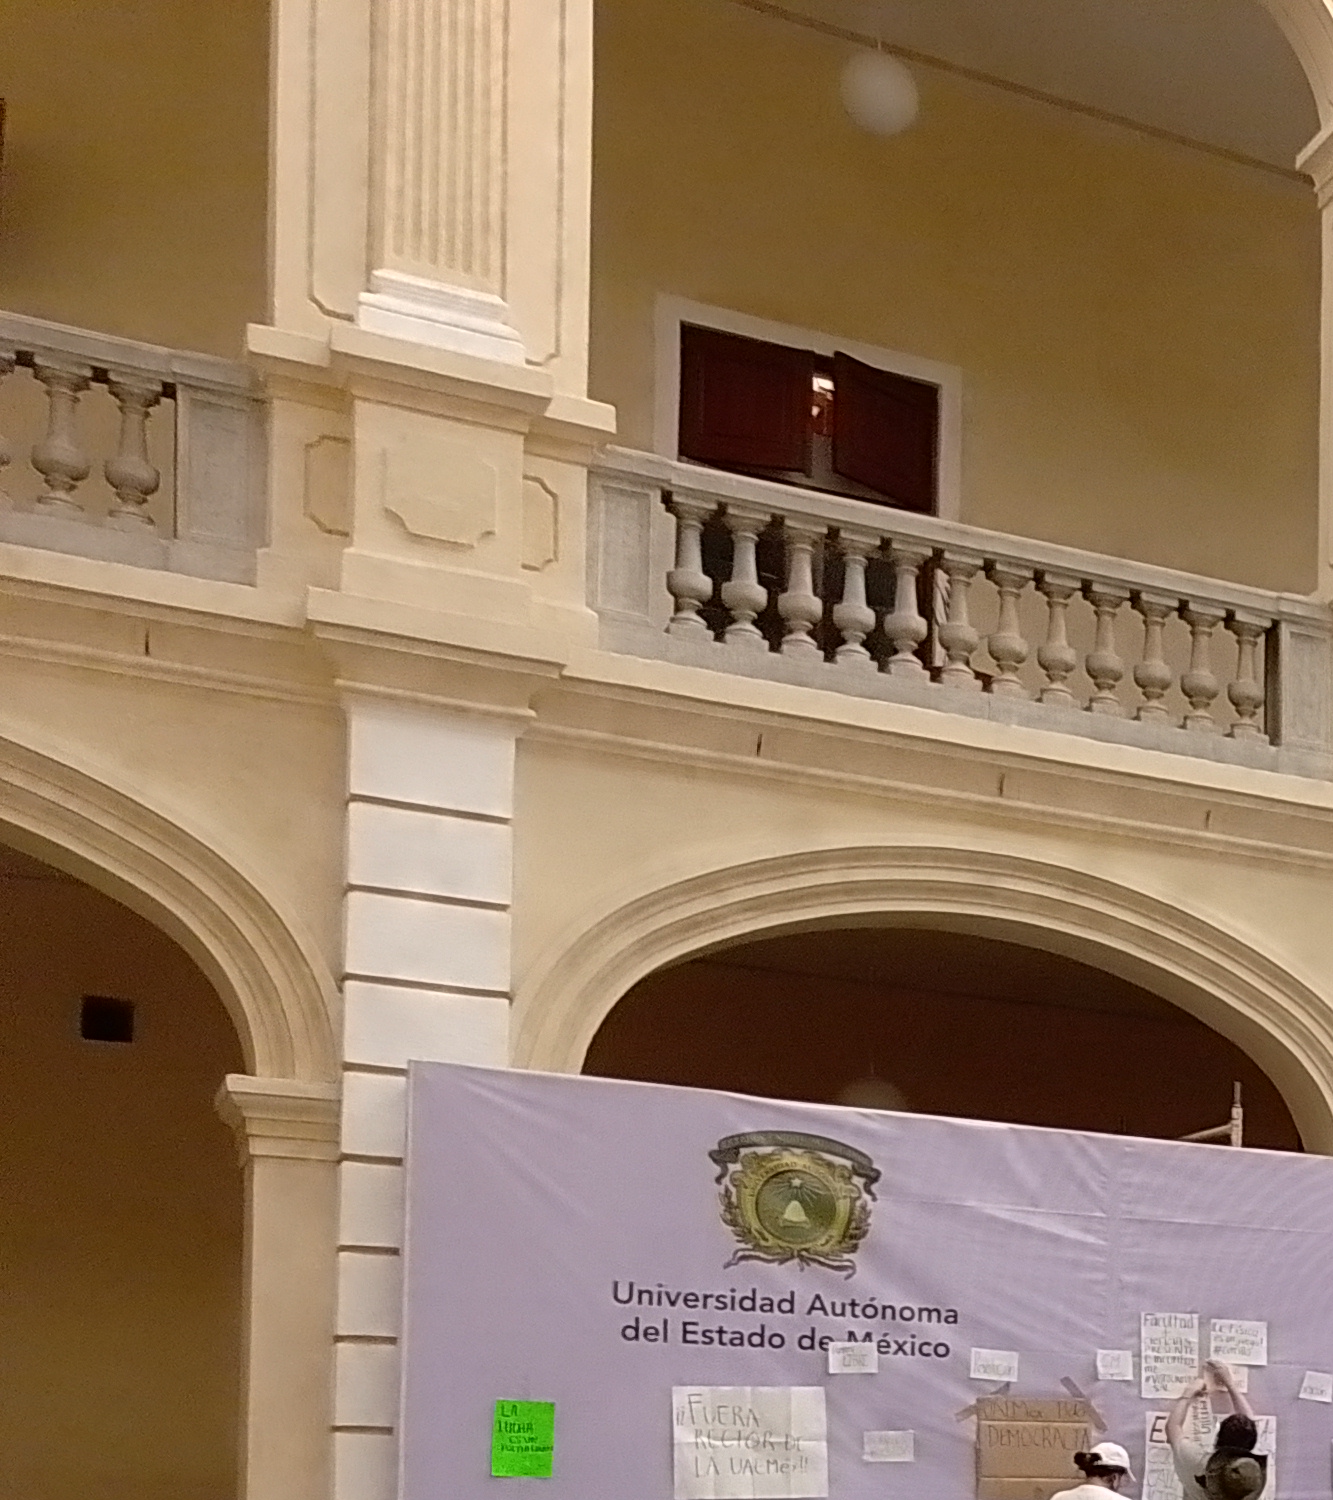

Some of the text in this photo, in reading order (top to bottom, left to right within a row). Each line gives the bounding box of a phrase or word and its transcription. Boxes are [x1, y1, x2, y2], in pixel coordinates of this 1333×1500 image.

[612, 1280, 959, 1325] Universidad Autónoma
[621, 1317, 669, 1343] del
[681, 1321, 786, 1349] Estado
[797, 1327, 834, 1352] de
